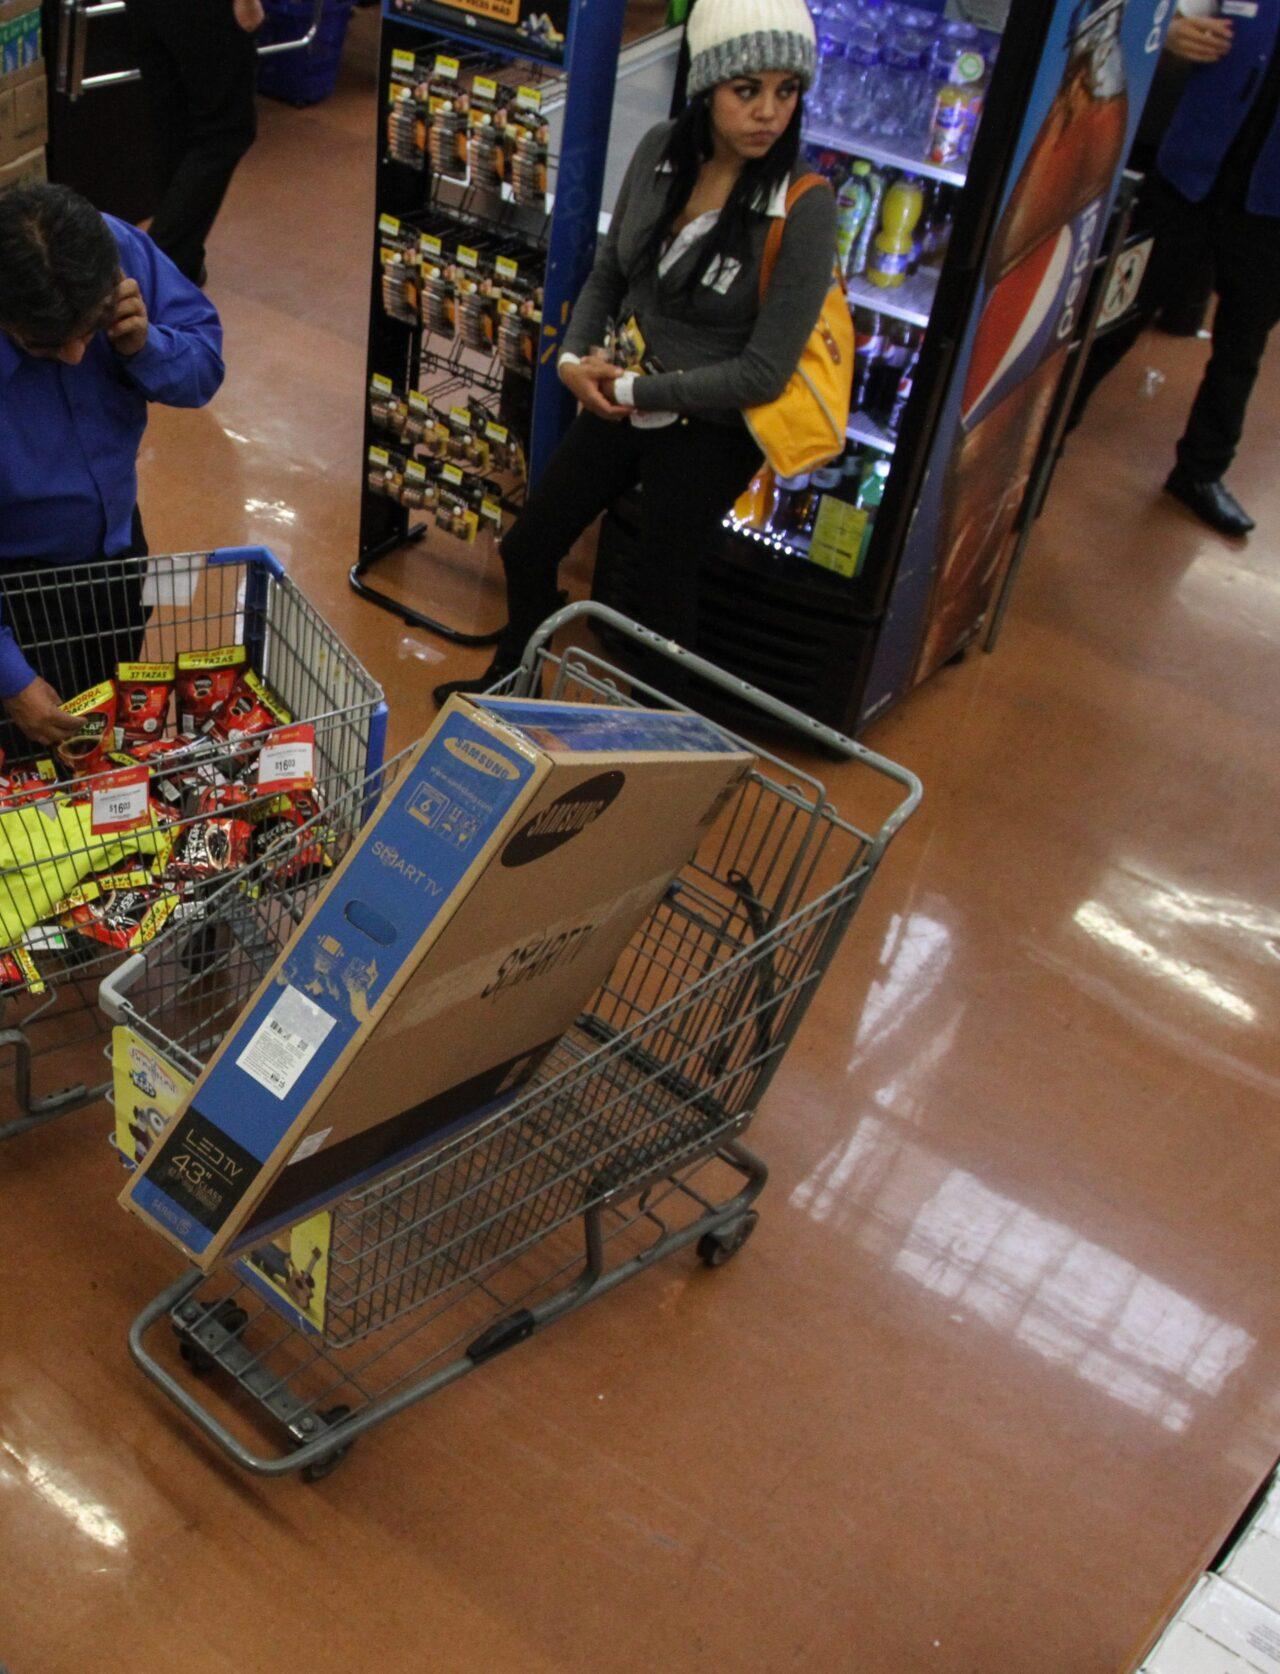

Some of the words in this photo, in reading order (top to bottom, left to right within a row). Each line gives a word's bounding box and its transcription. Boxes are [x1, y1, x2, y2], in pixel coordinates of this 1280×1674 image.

[141, 671, 168, 680] TAZAS
[454, 738, 511, 780] SAMSUNG
[371, 840, 427, 885] SMART
[423, 878, 444, 897] TV
[171, 1154, 213, 1185] 43"
[223, 1155, 244, 1177] TV
